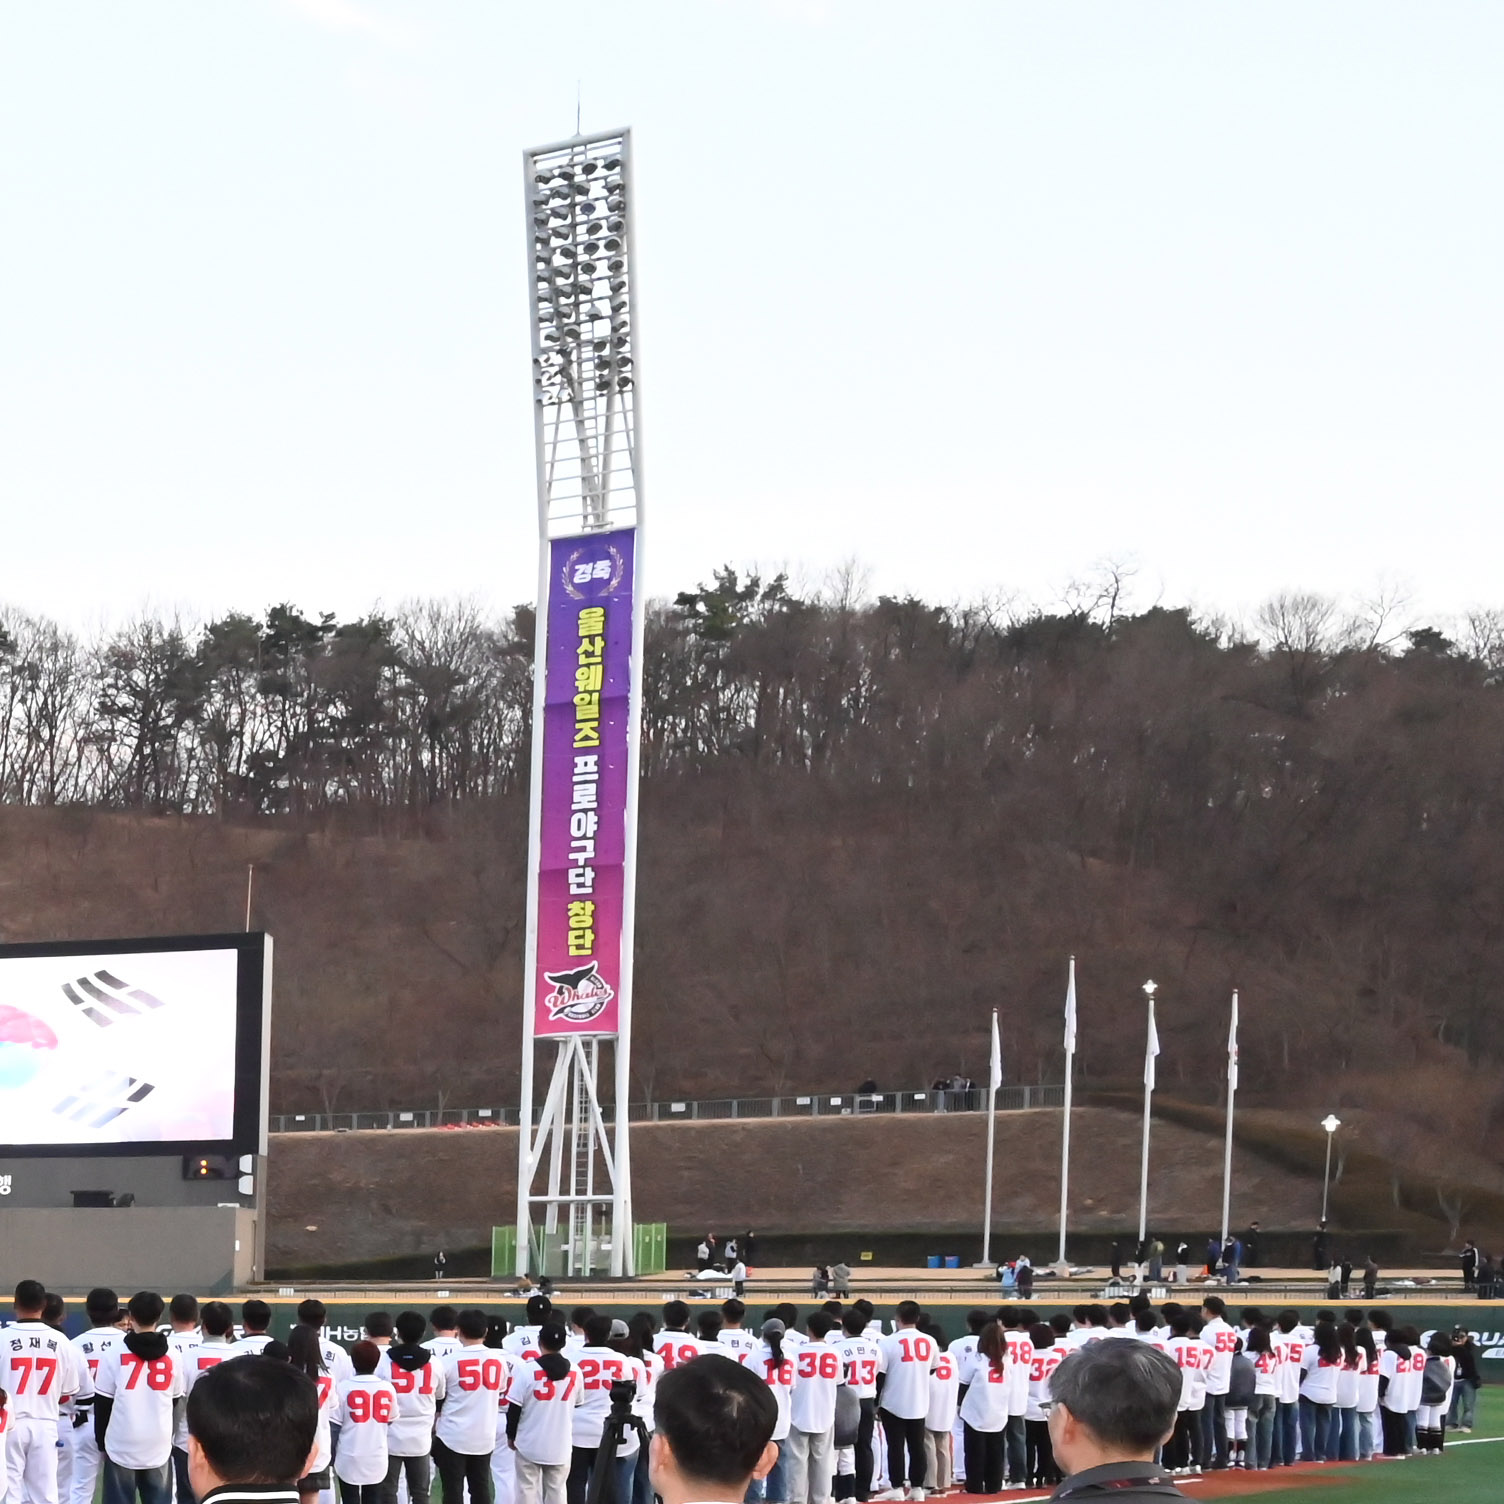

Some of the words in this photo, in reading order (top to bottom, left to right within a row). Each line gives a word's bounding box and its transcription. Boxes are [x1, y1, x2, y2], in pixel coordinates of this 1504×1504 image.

[573, 560, 611, 584] 경축
[572, 606, 605, 748] 울산웨일즈
[568, 754, 599, 895] 프로야구단
[567, 900, 595, 956] 창단
[548, 985, 608, 1009] Whales
[899, 1337, 931, 1362] 10
[1175, 1346, 1198, 1368] 15
[1214, 1332, 1237, 1352] 55
[10, 1357, 57, 1395] 77
[120, 1353, 173, 1391] 78
[391, 1362, 432, 1395] 51
[458, 1358, 502, 1391] 50
[577, 1359, 623, 1390] 23
[798, 1352, 838, 1379] 36
[847, 1360, 876, 1385] 13
[533, 1370, 577, 1401] 37
[347, 1390, 392, 1423] 96
